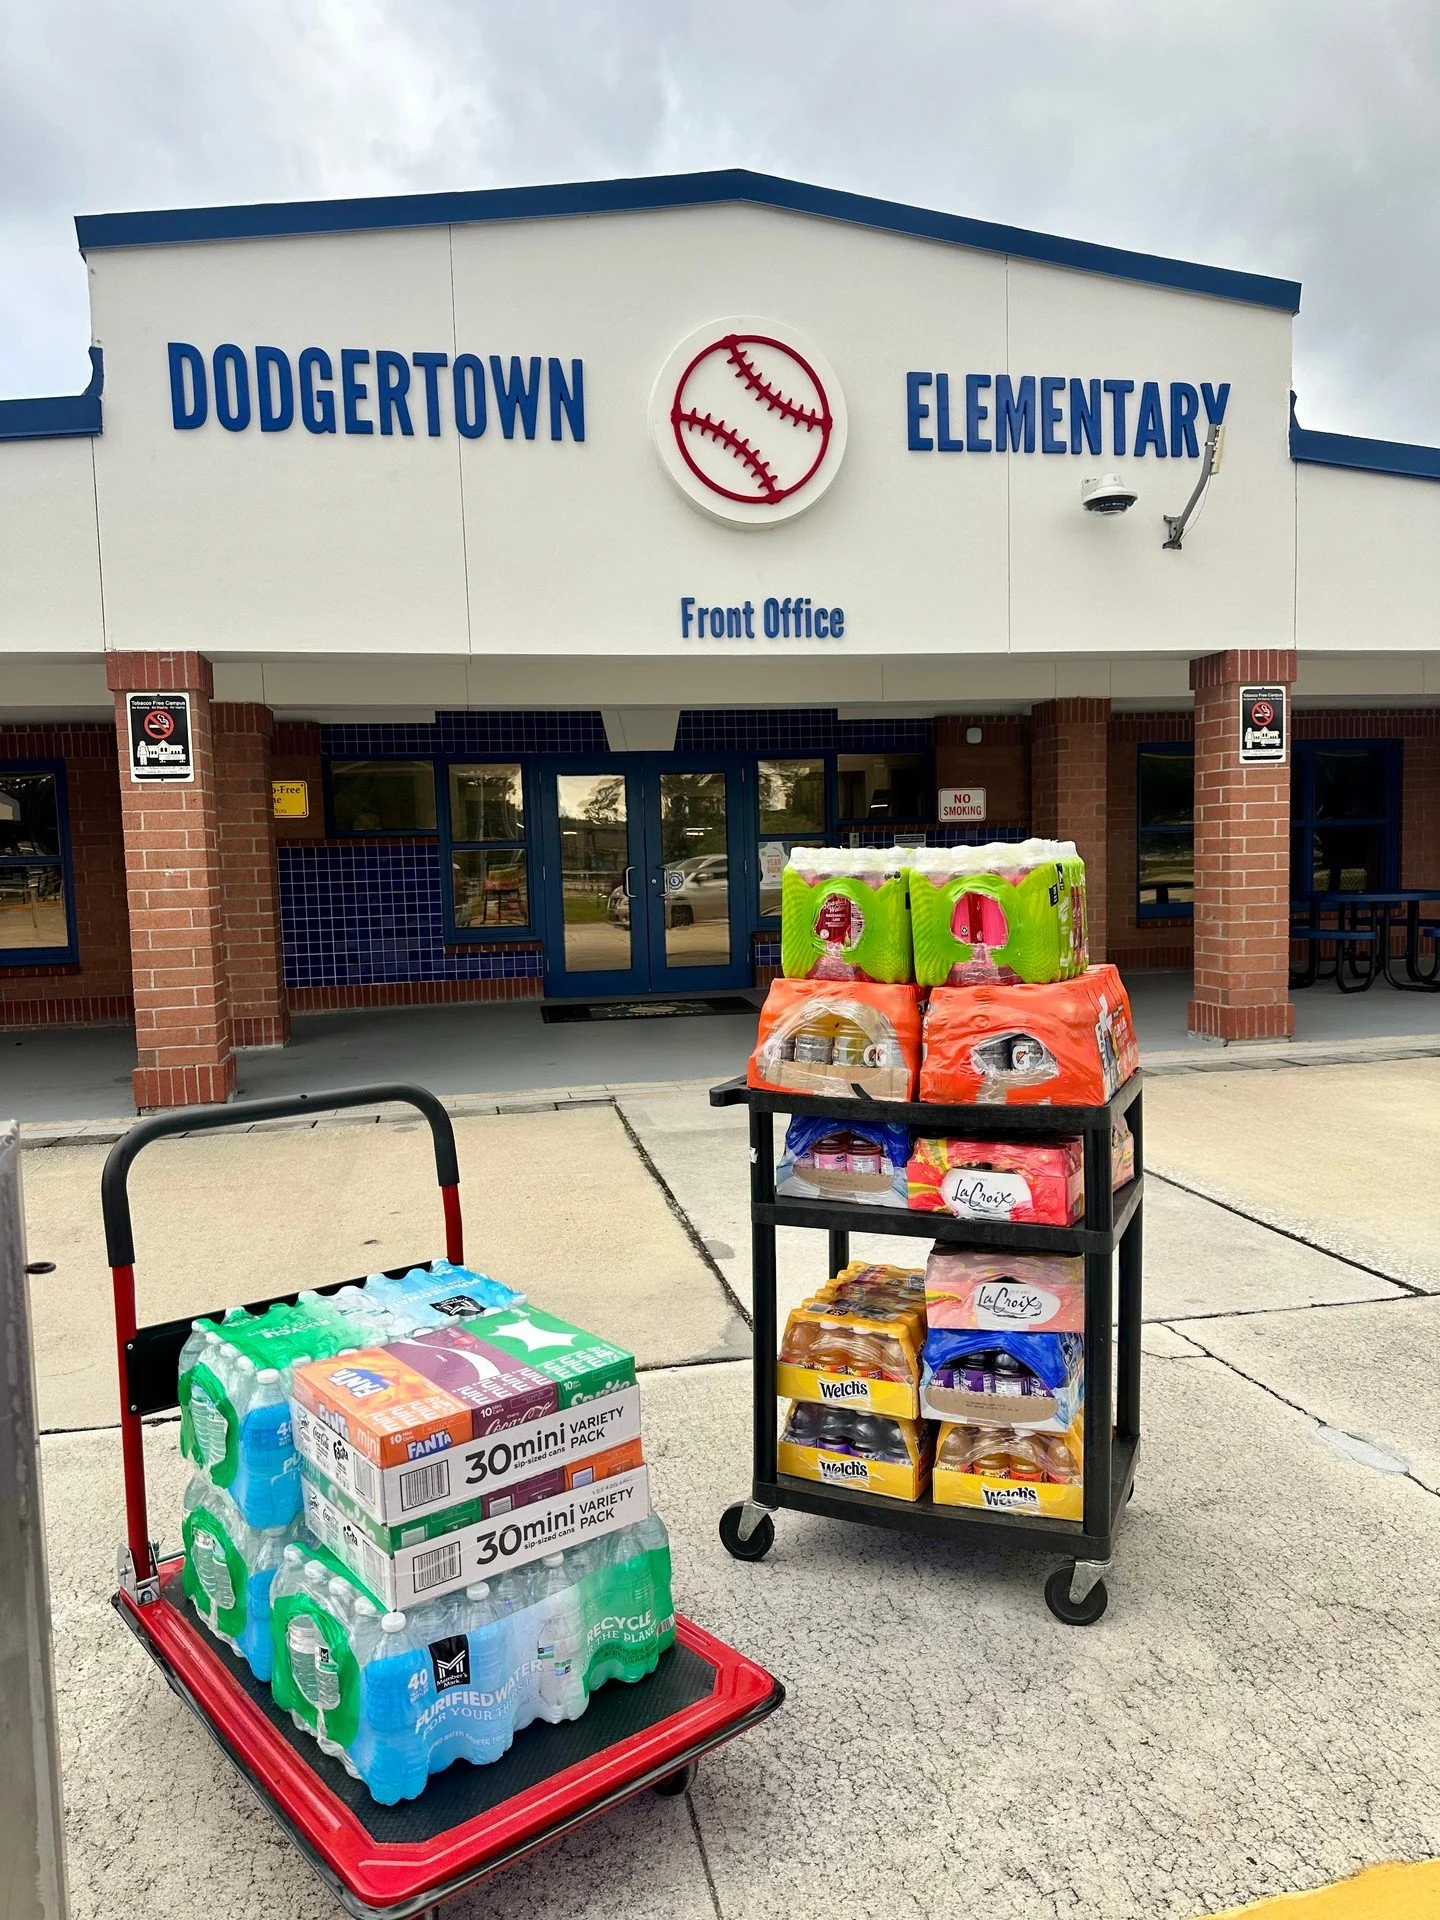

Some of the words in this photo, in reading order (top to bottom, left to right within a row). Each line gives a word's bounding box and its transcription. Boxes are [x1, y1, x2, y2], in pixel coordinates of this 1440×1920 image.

[168, 342, 585, 442] DODGERTOWN
[906, 372, 1231, 458] ELEMENTARY
[681, 597, 755, 639] Front
[763, 597, 845, 639] Office
[954, 794, 971, 804] NO
[943, 805, 982, 817] SMOKING
[1012, 1045, 1030, 1070] G
[564, 1382, 573, 1390] 10
[819, 1380, 869, 1399] Welch's
[480, 1407, 493, 1418] 10
[570, 1406, 624, 1435] VARIETY
[390, 1433, 403, 1445] 10
[407, 1430, 452, 1460] FANTA
[571, 1427, 606, 1449] PACK
[514, 1452, 547, 1469] sip-sized
[548, 1447, 566, 1457] cans
[579, 1486, 634, 1515] VARIETY
[580, 1508, 615, 1530] PACK
[524, 1533, 557, 1550] sip-sized
[559, 1527, 575, 1538] cans
[586, 1609, 652, 1647] RECYCLE
[597, 1630, 620, 1645] THE
[623, 1619, 657, 1643] PLANET
[408, 1668, 428, 1690] 40
[437, 1672, 468, 1686] Member's
[414, 1690, 494, 1735] PURIFIED
[495, 1659, 543, 1704] WATER
[450, 1706, 492, 1721] YOUR
